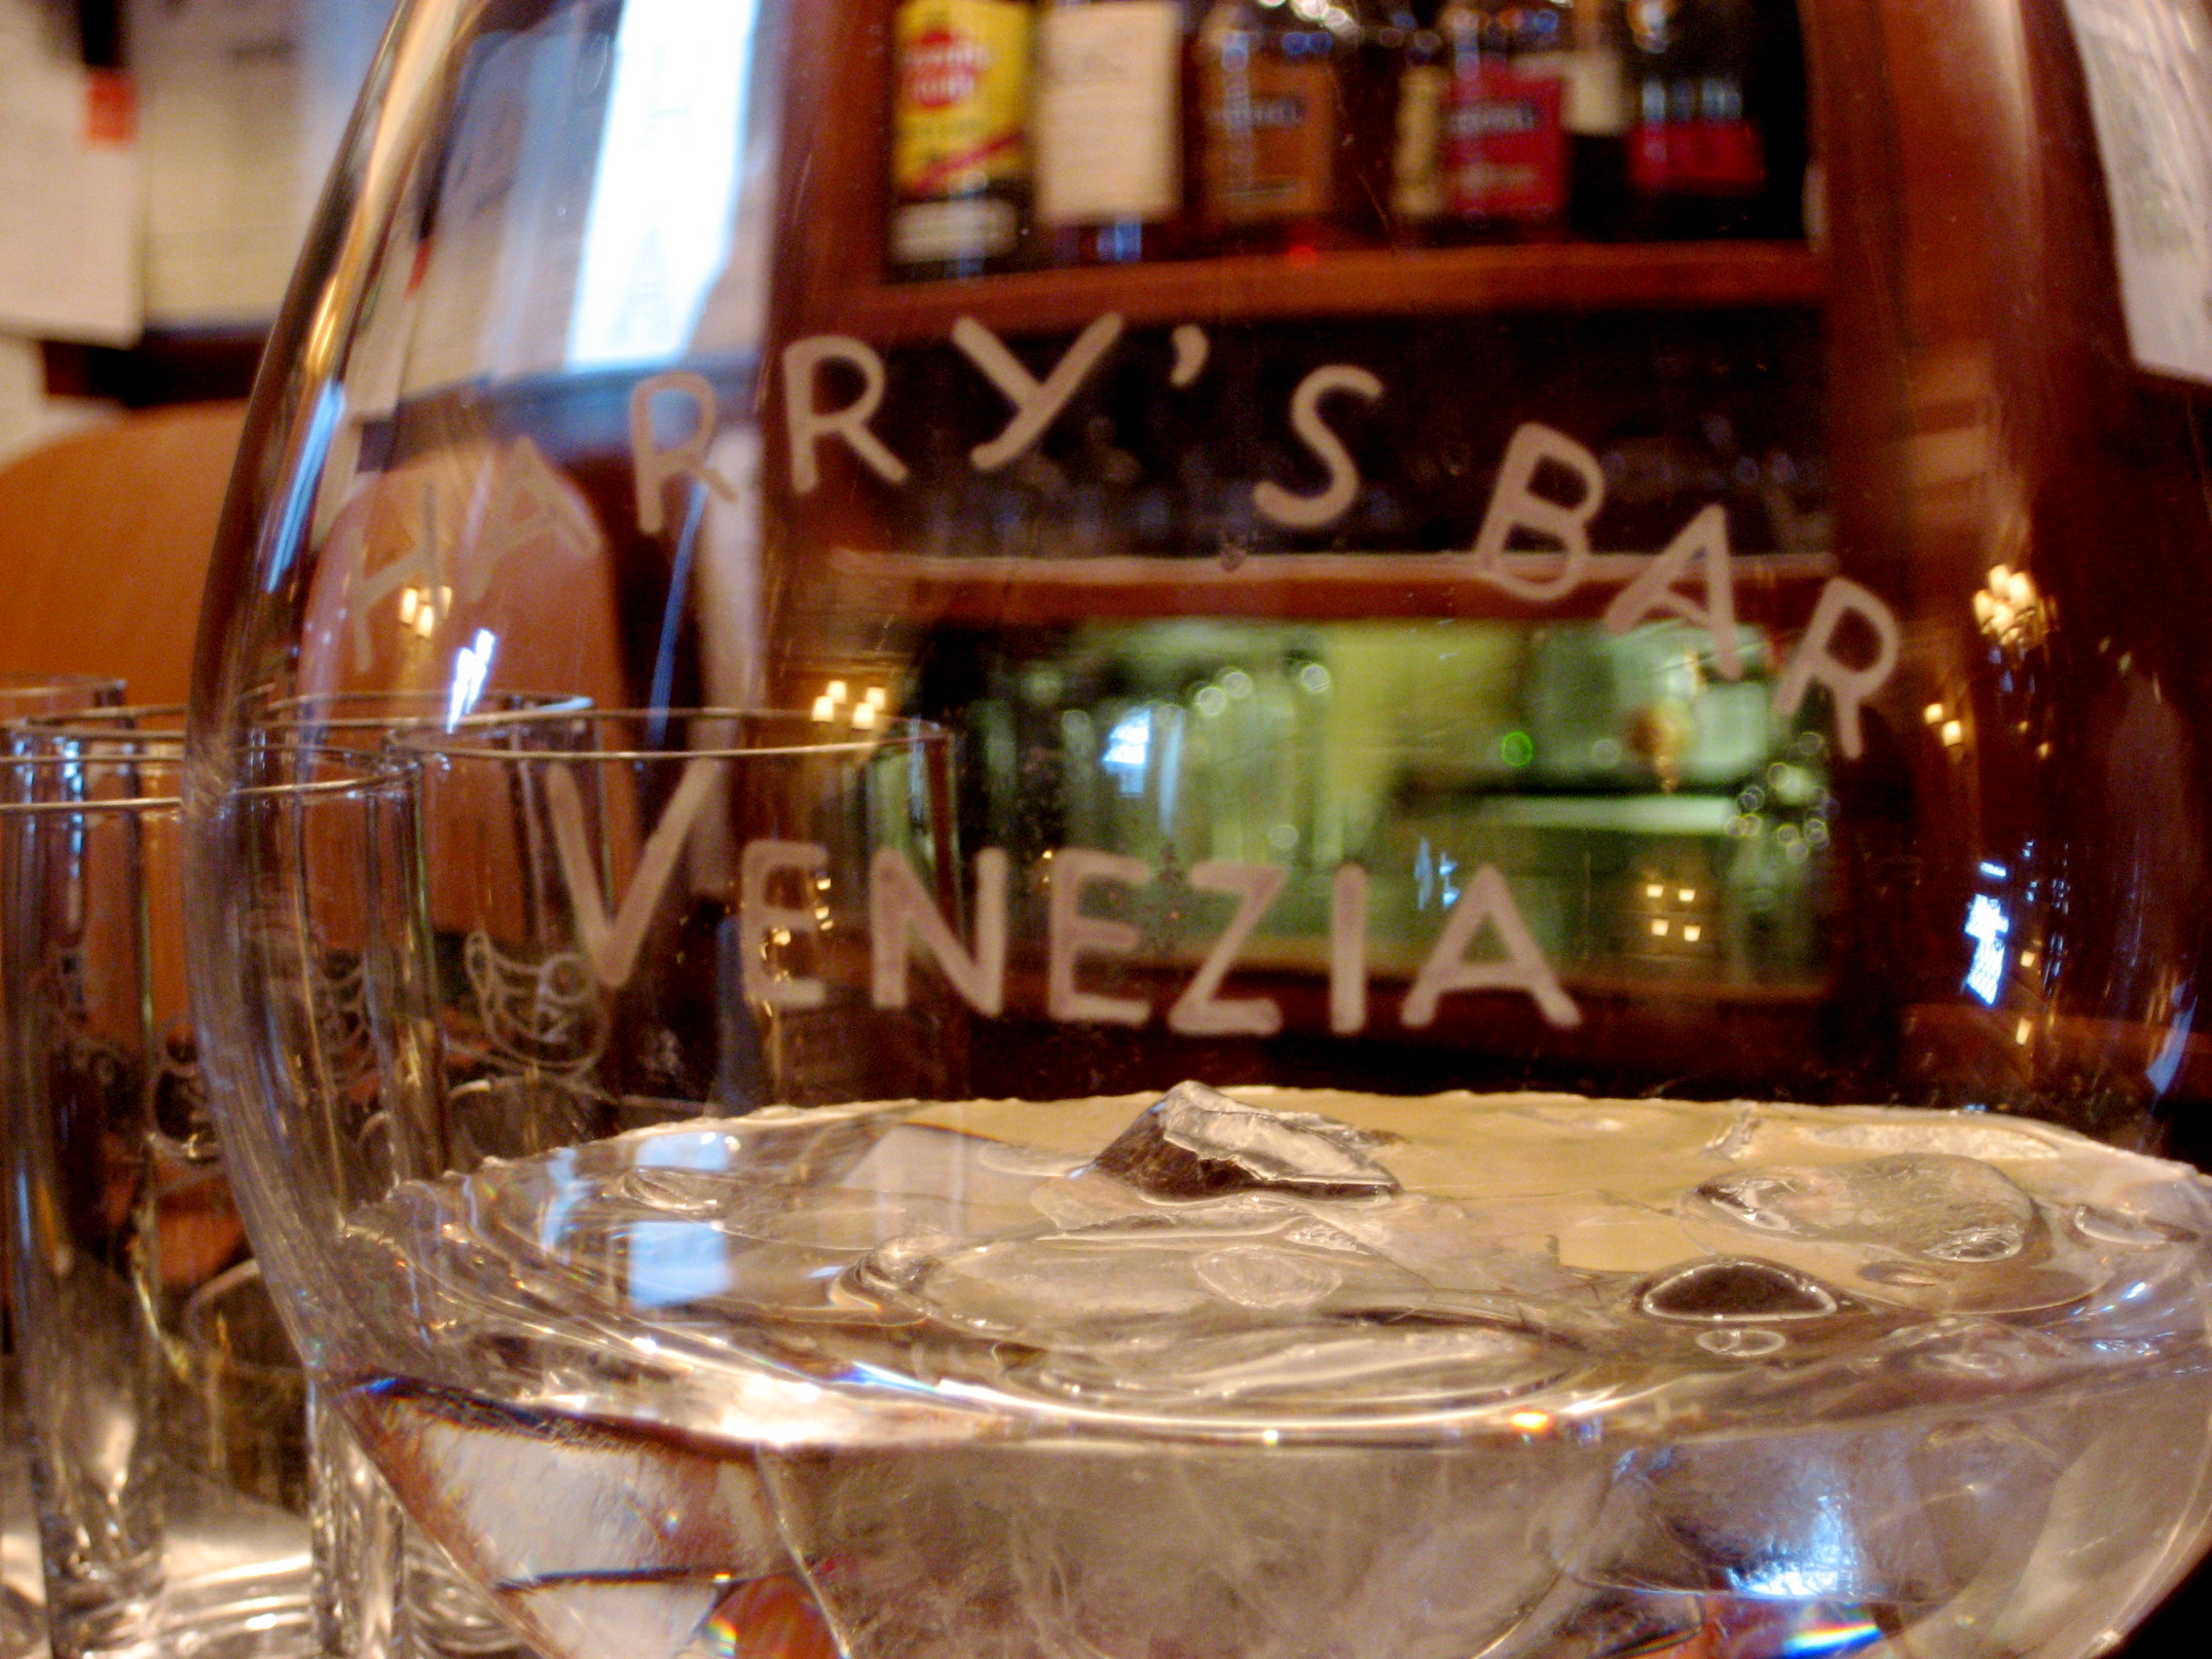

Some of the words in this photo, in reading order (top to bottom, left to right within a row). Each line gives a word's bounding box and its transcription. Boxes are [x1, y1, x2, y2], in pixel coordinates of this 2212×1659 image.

[347, 313, 1383, 674] HARRY'S
[1476, 422, 1900, 760] BAR
[545, 756, 1582, 1036] VENEZIA
